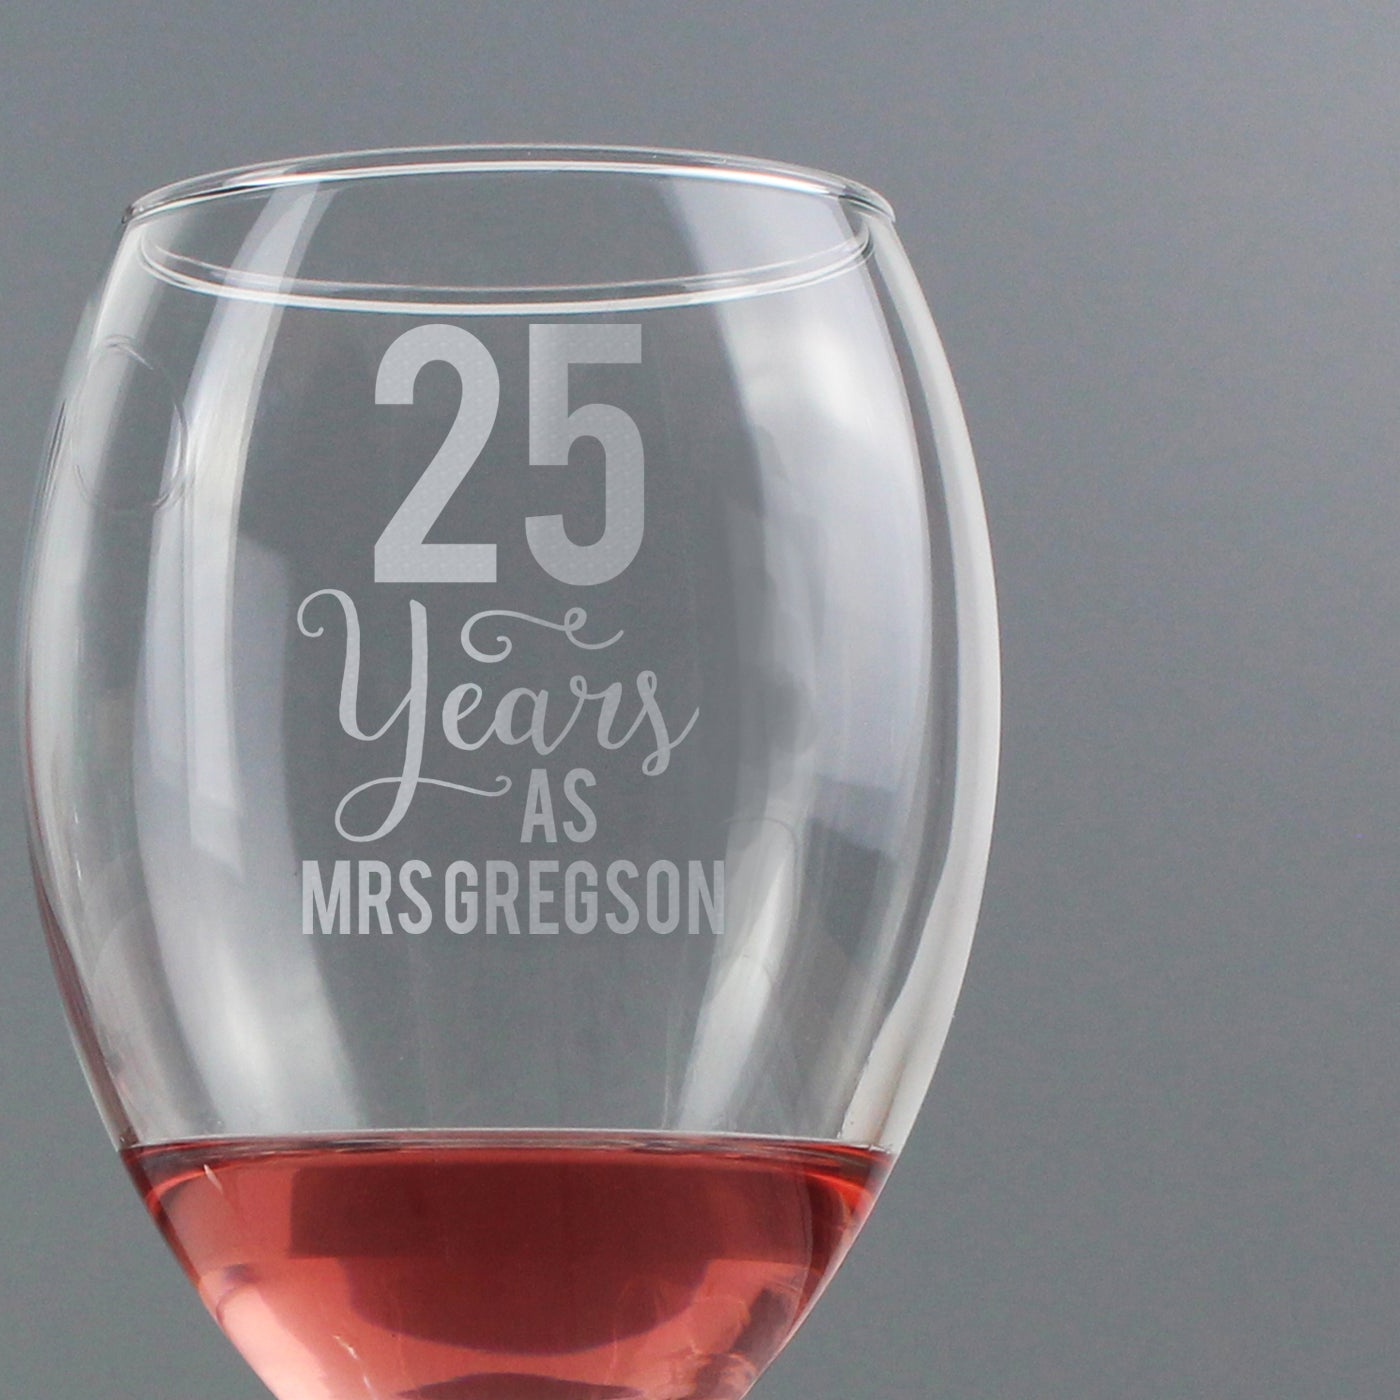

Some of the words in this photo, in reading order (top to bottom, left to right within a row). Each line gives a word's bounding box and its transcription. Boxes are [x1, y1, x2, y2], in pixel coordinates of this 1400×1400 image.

[373, 323, 645, 586] 25
[296, 588, 700, 842] Years
[520, 768, 598, 844] AS
[301, 859, 433, 935] MRS
[444, 859, 726, 935] GREGSON
